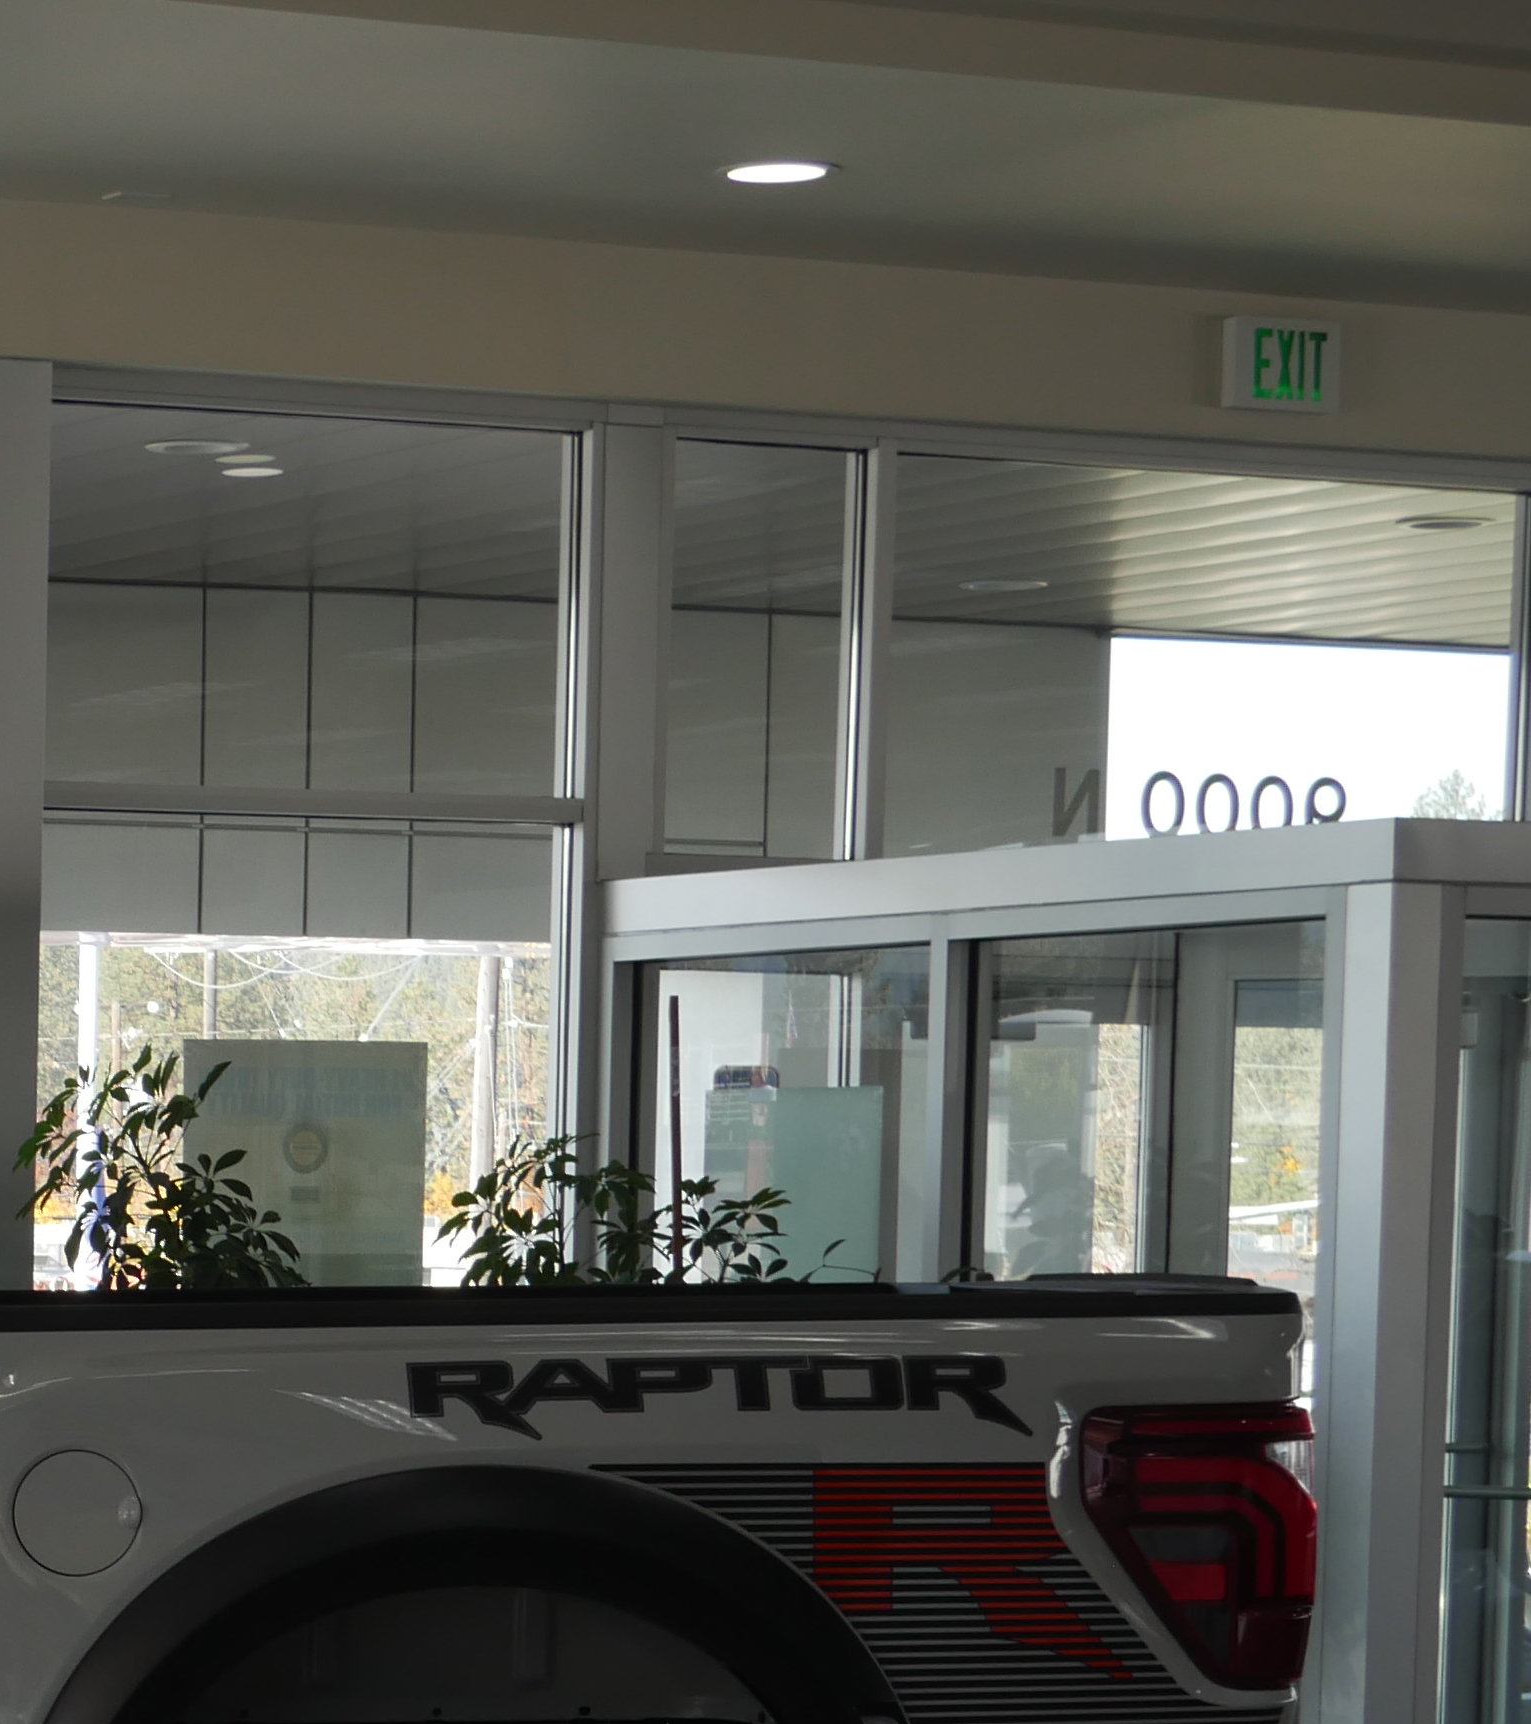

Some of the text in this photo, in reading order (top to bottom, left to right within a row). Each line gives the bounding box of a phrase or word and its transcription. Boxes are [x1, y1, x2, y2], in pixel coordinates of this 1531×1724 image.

[1252, 327, 1328, 402] EXIT
[407, 1355, 1033, 1440] RAPTOR
[812, 1463, 1135, 1680] R
